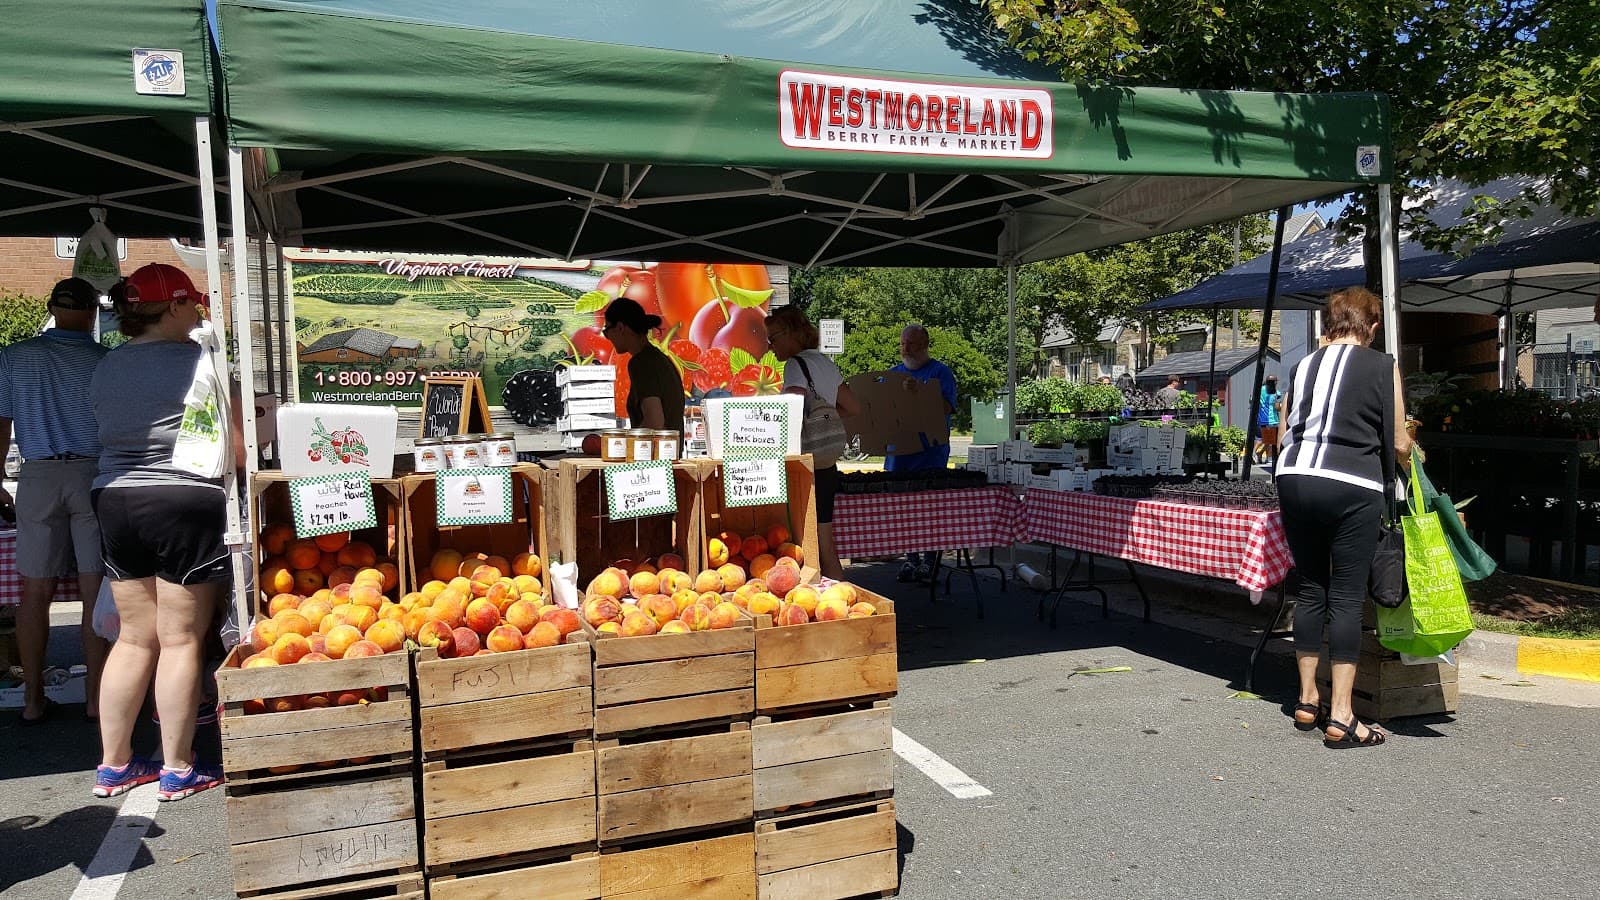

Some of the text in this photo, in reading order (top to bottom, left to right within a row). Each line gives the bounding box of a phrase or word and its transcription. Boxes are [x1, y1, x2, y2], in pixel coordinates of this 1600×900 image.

[788, 82, 1043, 150] WESTMORELAND
[827, 130, 1017, 151] BERRY FARM & MARKET
[378, 258, 521, 282] Virginia's Finest!
[752, 435, 775, 444] boxes
[343, 480, 362, 490] Red
[623, 489, 662, 500] Peach Salsa
[315, 501, 348, 510] Peaches
